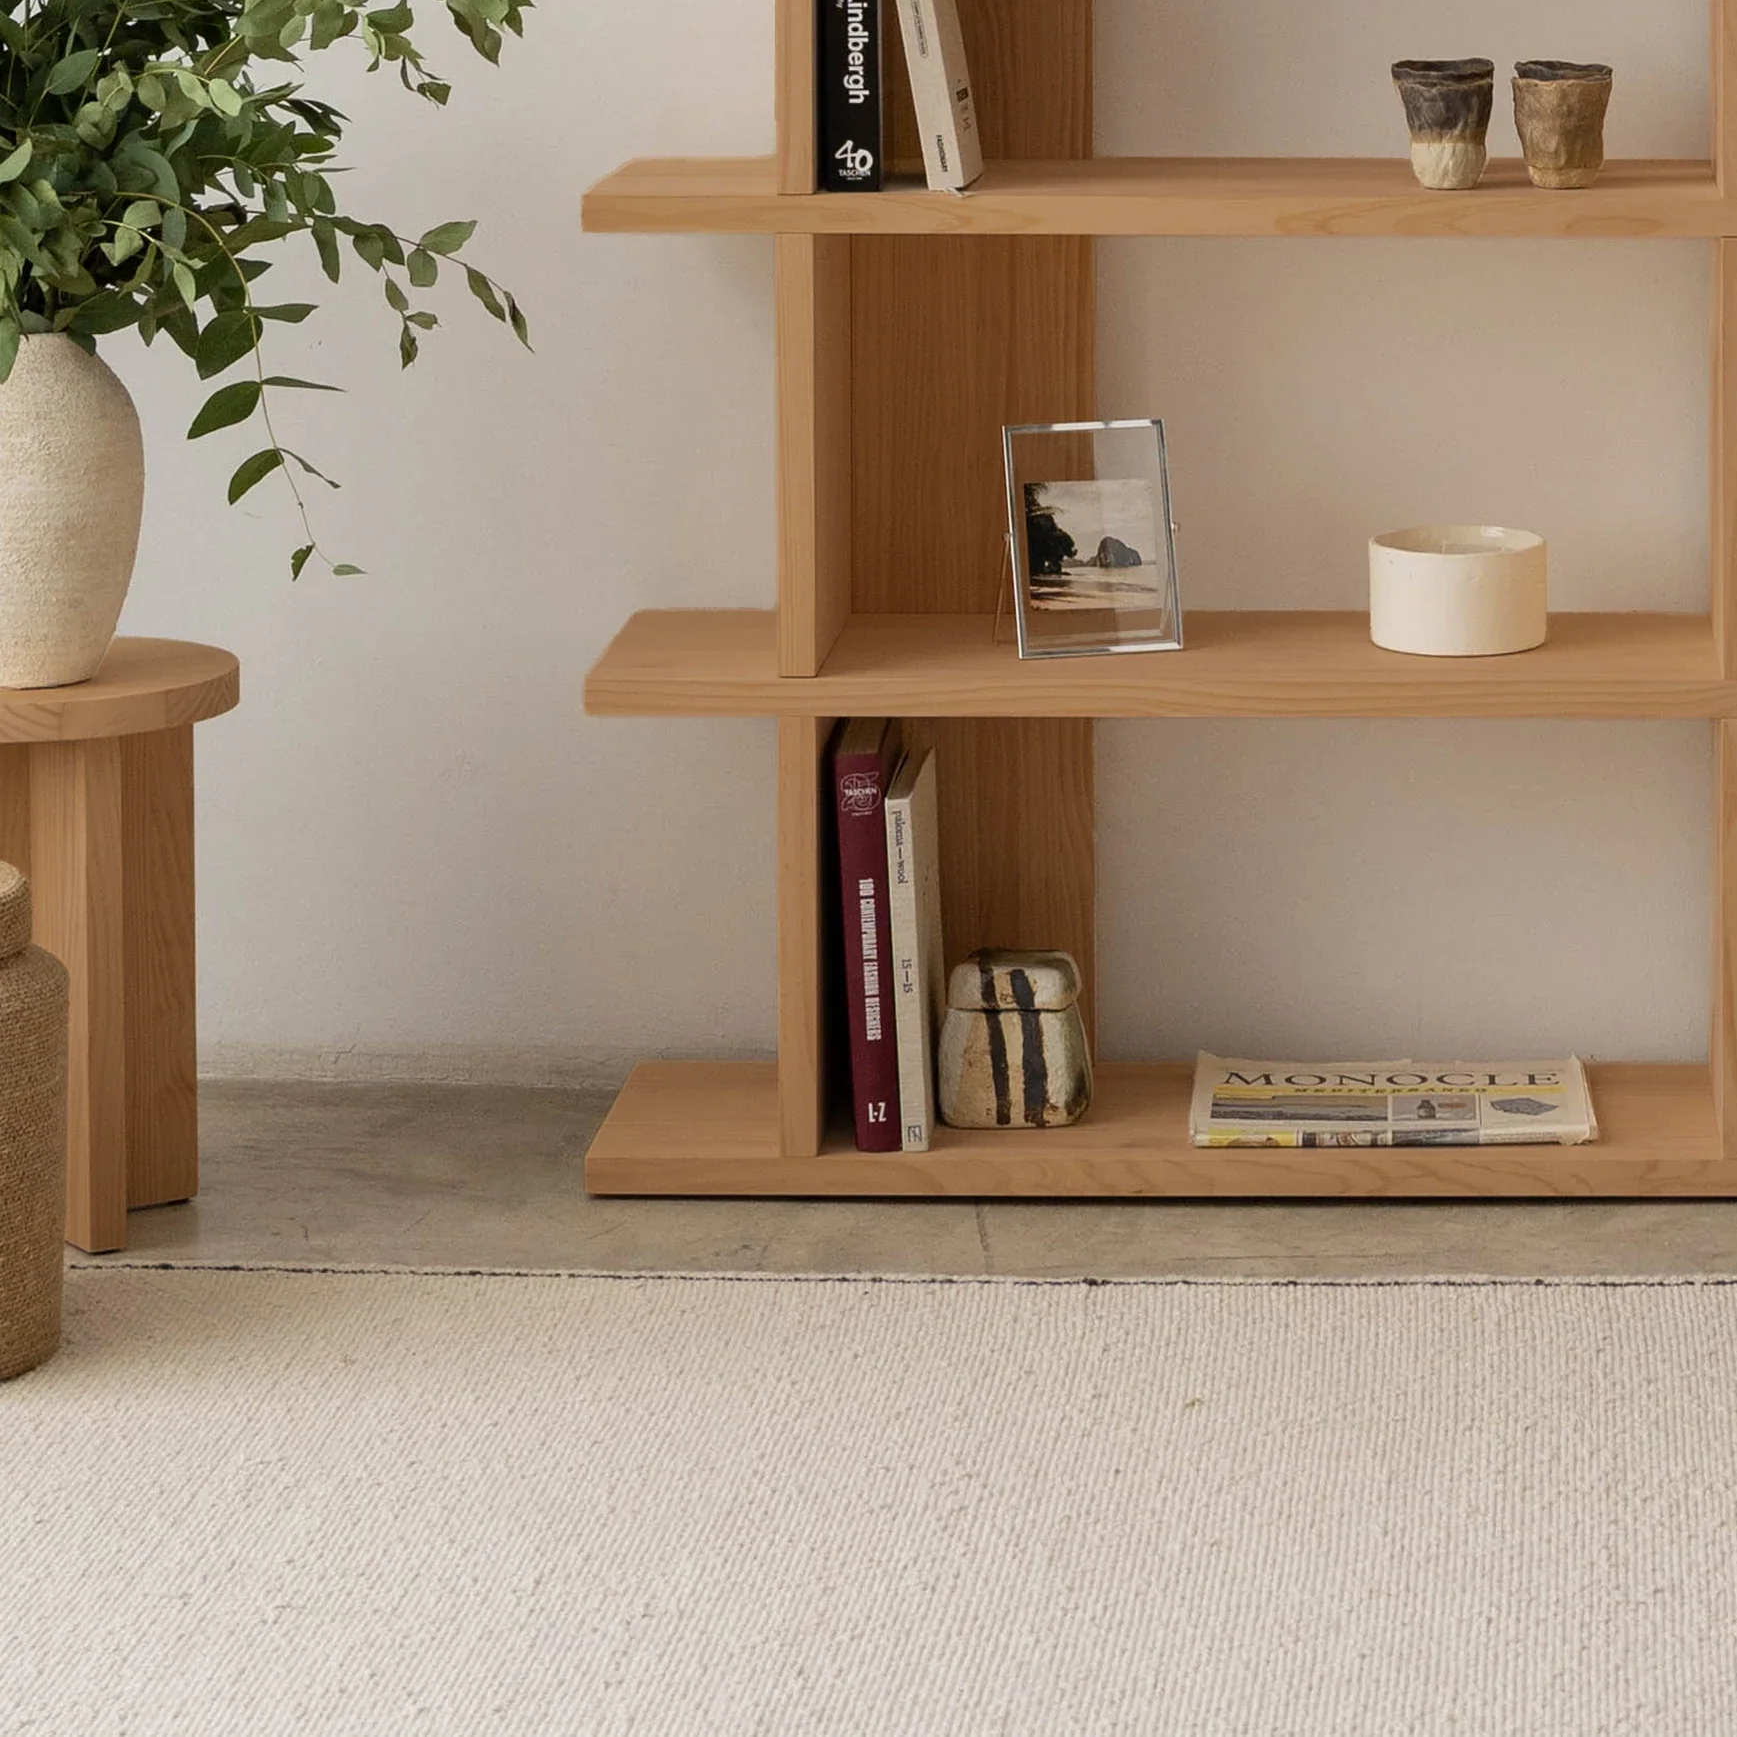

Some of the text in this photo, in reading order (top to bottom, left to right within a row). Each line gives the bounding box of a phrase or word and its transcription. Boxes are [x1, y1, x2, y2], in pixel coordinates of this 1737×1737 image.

[834, 140, 873, 172] 40
[859, 878, 882, 1041] 100 CONTEMPORARY FASHION DESIGNERS
[1221, 1071, 1561, 1086] MONOCLE
